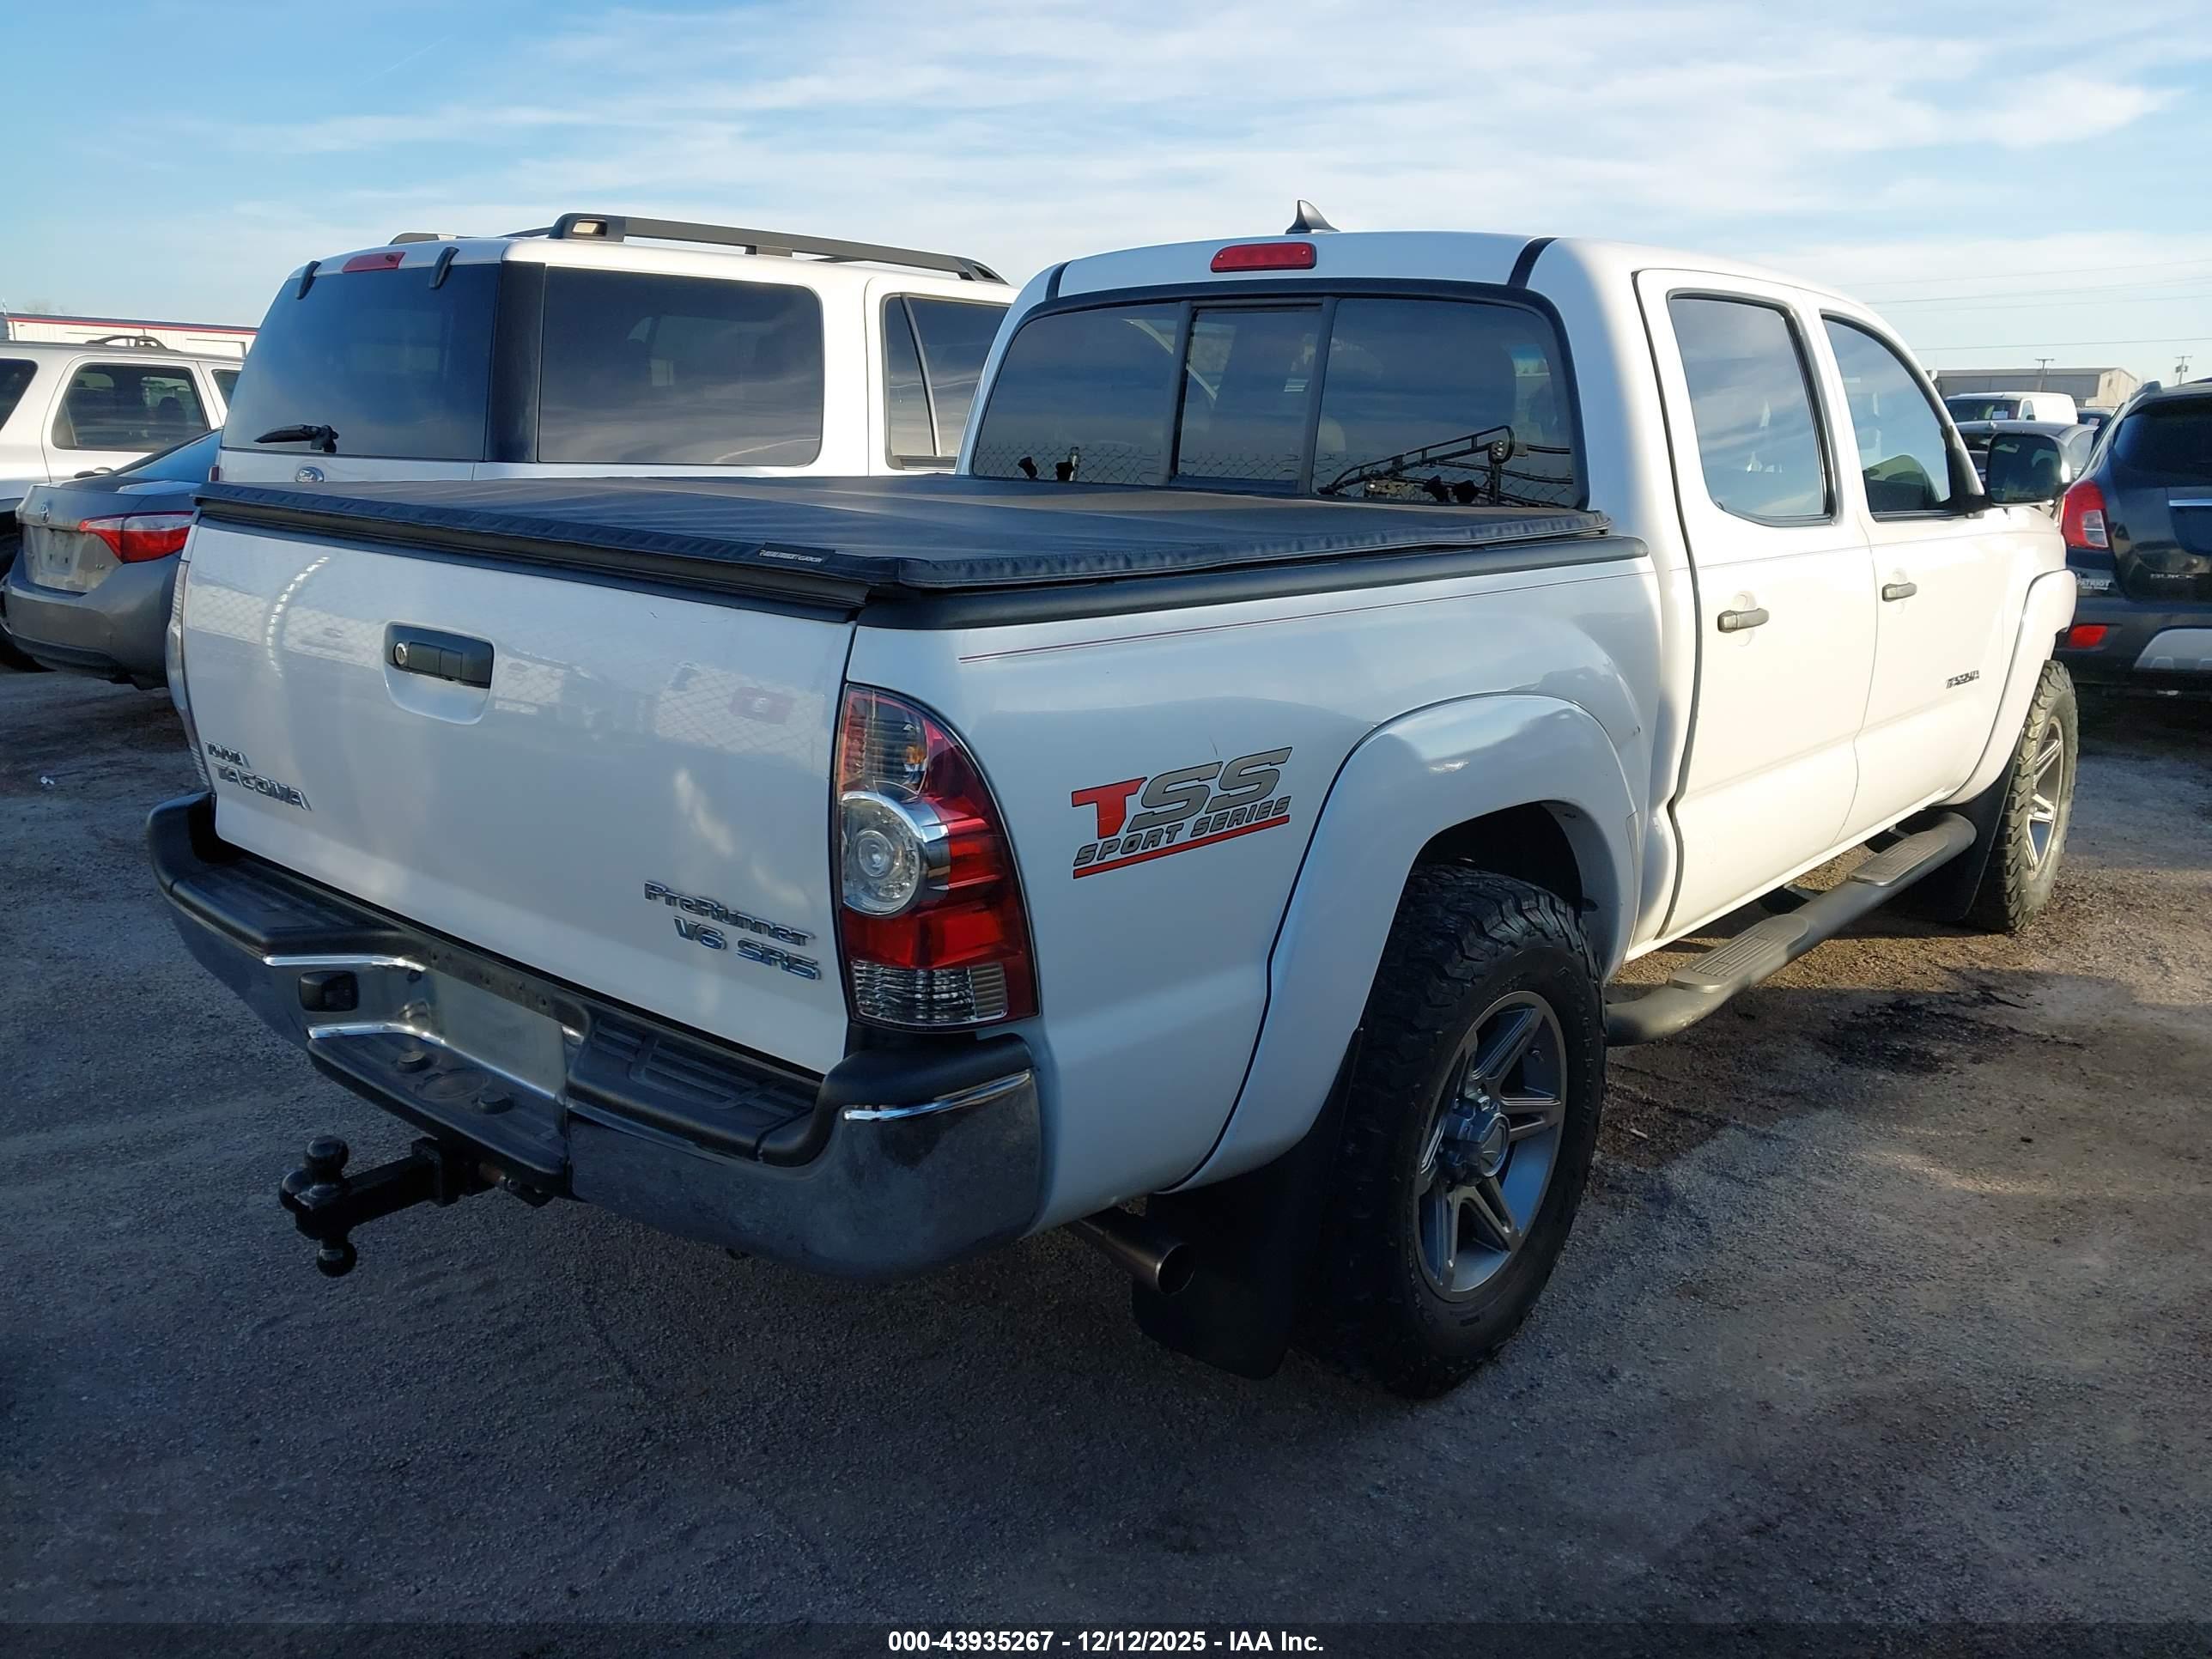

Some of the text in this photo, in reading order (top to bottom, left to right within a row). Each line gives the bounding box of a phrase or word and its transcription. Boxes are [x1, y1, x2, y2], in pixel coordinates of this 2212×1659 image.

[212, 761, 313, 811] TACOMA
[1071, 746, 1293, 840] TSS
[1073, 795, 1292, 868] SPORT SERIES
[644, 880, 817, 946] PreRunner
[673, 915, 822, 981] V6 SR5
